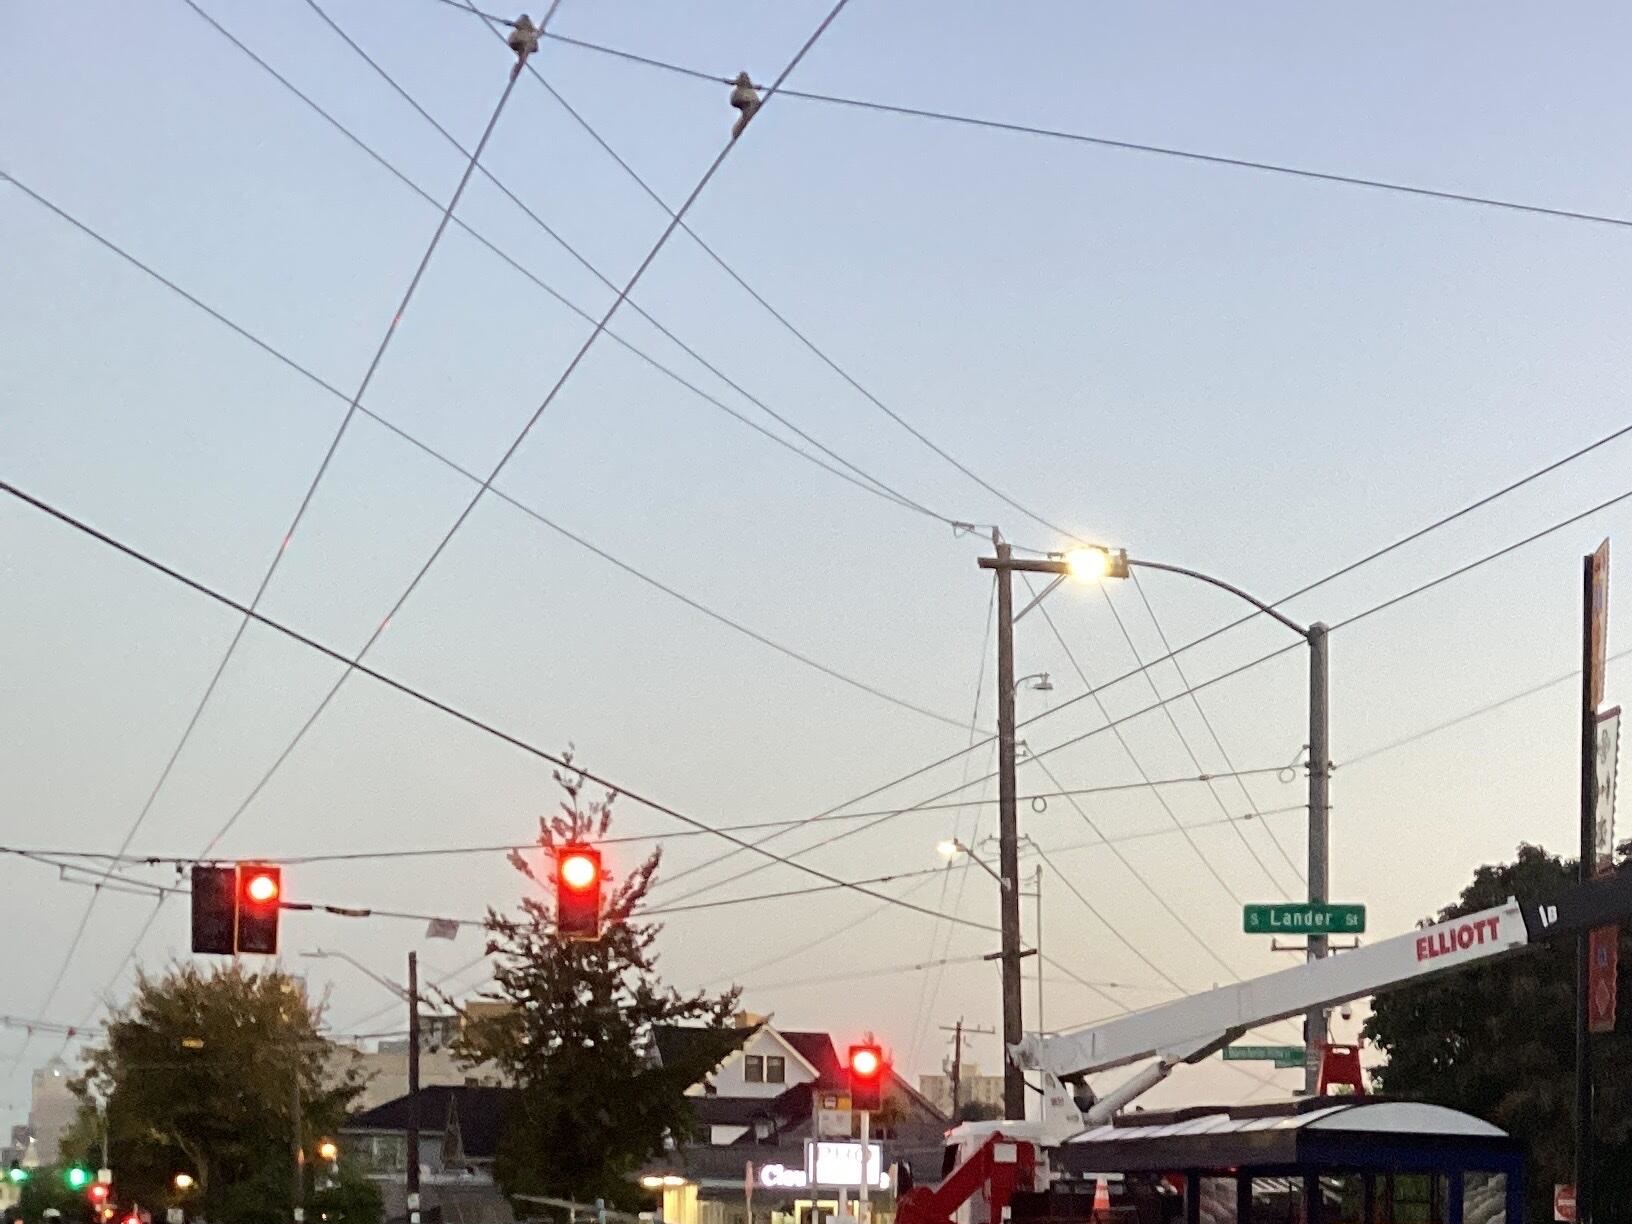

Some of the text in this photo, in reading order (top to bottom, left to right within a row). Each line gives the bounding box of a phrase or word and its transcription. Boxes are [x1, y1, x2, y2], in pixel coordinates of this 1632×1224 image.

[1250, 910, 1358, 926] S Lander St
[1416, 917, 1500, 962] ELLIOTT
